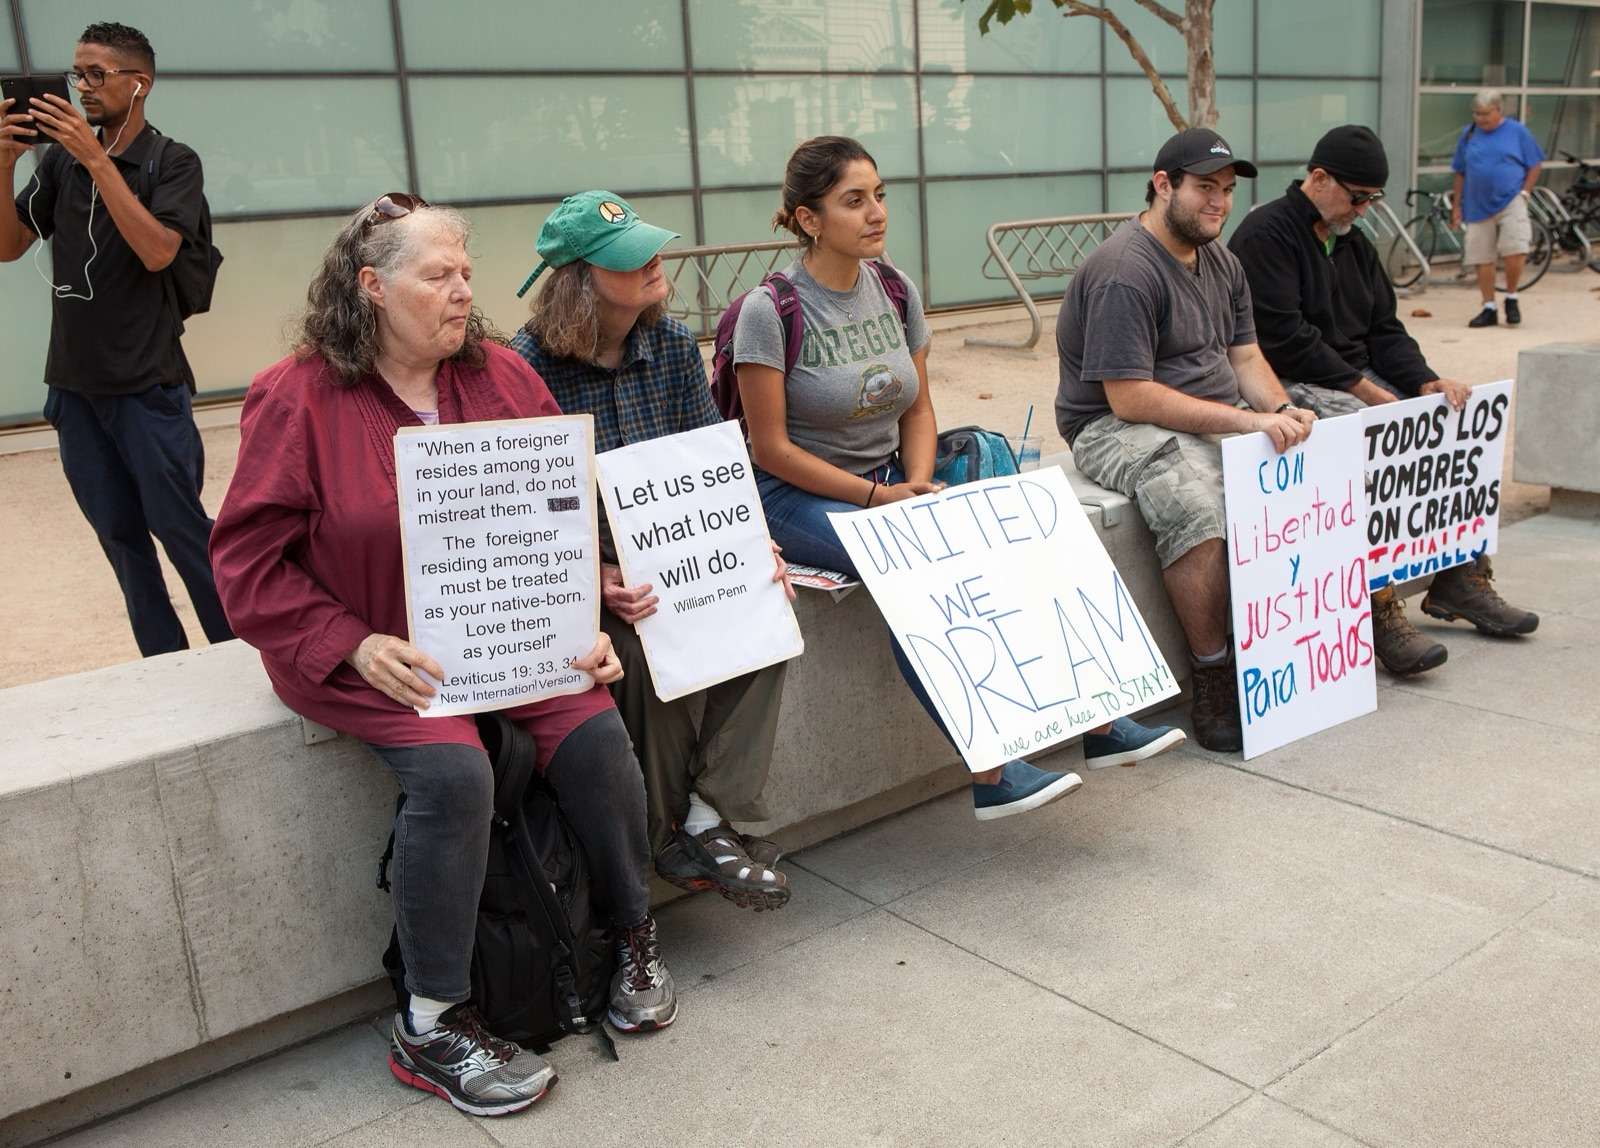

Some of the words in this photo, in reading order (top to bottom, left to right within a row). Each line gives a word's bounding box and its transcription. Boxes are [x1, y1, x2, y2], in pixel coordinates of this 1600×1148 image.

[1364, 404, 1449, 461] TODOS
[1456, 393, 1508, 442] LOS
[417, 440, 474, 457] "When
[480, 441, 491, 452] a
[496, 433, 569, 451] foreigner
[416, 463, 478, 480] resides
[483, 458, 540, 475] among
[545, 456, 574, 473] you
[1258, 452, 1304, 494] CON
[417, 488, 432, 502] in
[437, 486, 475, 505] your
[480, 480, 520, 497] land,
[525, 478, 546, 492] do
[551, 475, 577, 490] not
[614, 478, 659, 511] Let
[664, 474, 695, 497] us
[701, 461, 746, 488] see
[418, 503, 486, 525] mistreat
[490, 503, 537, 517] them.
[631, 514, 695, 551] what
[699, 503, 750, 533] love
[851, 480, 1057, 575] UNITED
[1233, 479, 1356, 566] Libertad
[1366, 506, 1400, 546] ON
[1407, 479, 1500, 538] CREADOS
[443, 536, 475, 550] The
[486, 528, 559, 546] foreigner
[421, 556, 487, 575] residing
[493, 551, 549, 568] among
[554, 549, 583, 566] you
[659, 556, 701, 589] will
[708, 549, 746, 574] do.
[440, 579, 481, 595] must
[486, 575, 507, 590] be
[512, 569, 568, 588] treated
[424, 607, 444, 620] as
[449, 601, 487, 621] your
[491, 590, 586, 612] native-born.
[673, 592, 716, 613] William
[717, 583, 748, 601] Penn
[930, 575, 996, 625] WE
[466, 620, 506, 637] Love
[511, 616, 551, 631] them
[463, 647, 482, 659] as
[487, 634, 557, 656] yourself"
[906, 570, 1160, 749] DREAM
[441, 671, 506, 687] Leviticus
[511, 665, 532, 679] 19:
[537, 660, 558, 675] 33,
[1242, 661, 1298, 725] Para
[1293, 611, 1373, 691] Todos
[440, 692, 469, 704] New
[539, 674, 581, 689] Version
[1003, 737, 1030, 757] we
[1034, 720, 1062, 743] are
[1091, 691, 1120, 716] TO
[1119, 665, 1173, 706] STAY!
